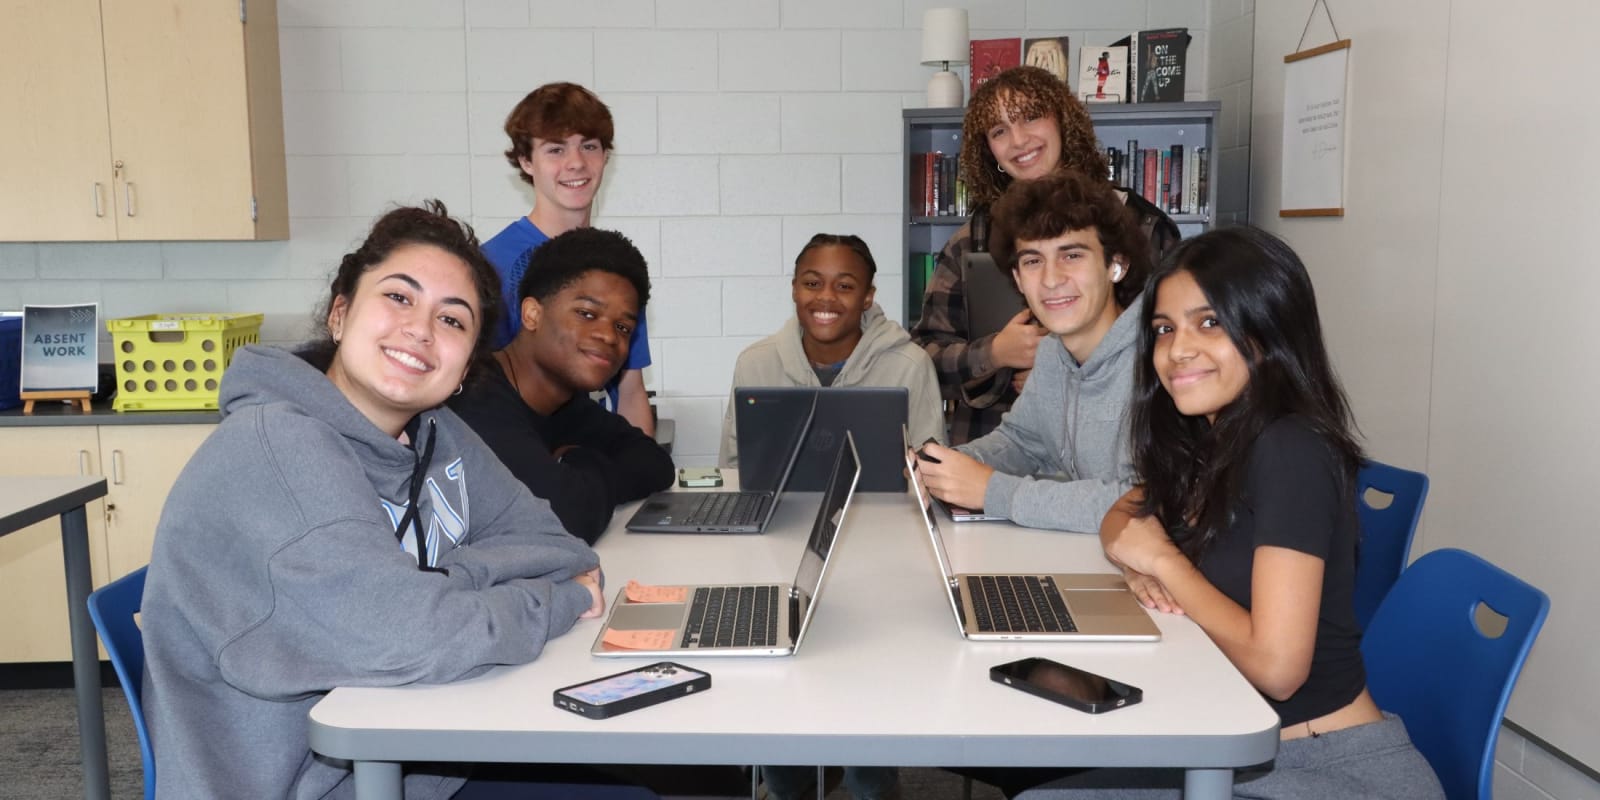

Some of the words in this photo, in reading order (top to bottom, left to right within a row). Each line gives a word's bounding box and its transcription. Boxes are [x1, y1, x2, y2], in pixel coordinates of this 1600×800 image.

[1155, 44, 1168, 55] ON
[1160, 55, 1176, 65] THE
[1156, 65, 1181, 77] COME
[33, 332, 86, 345] ABSENT
[43, 346, 86, 357] WORK
